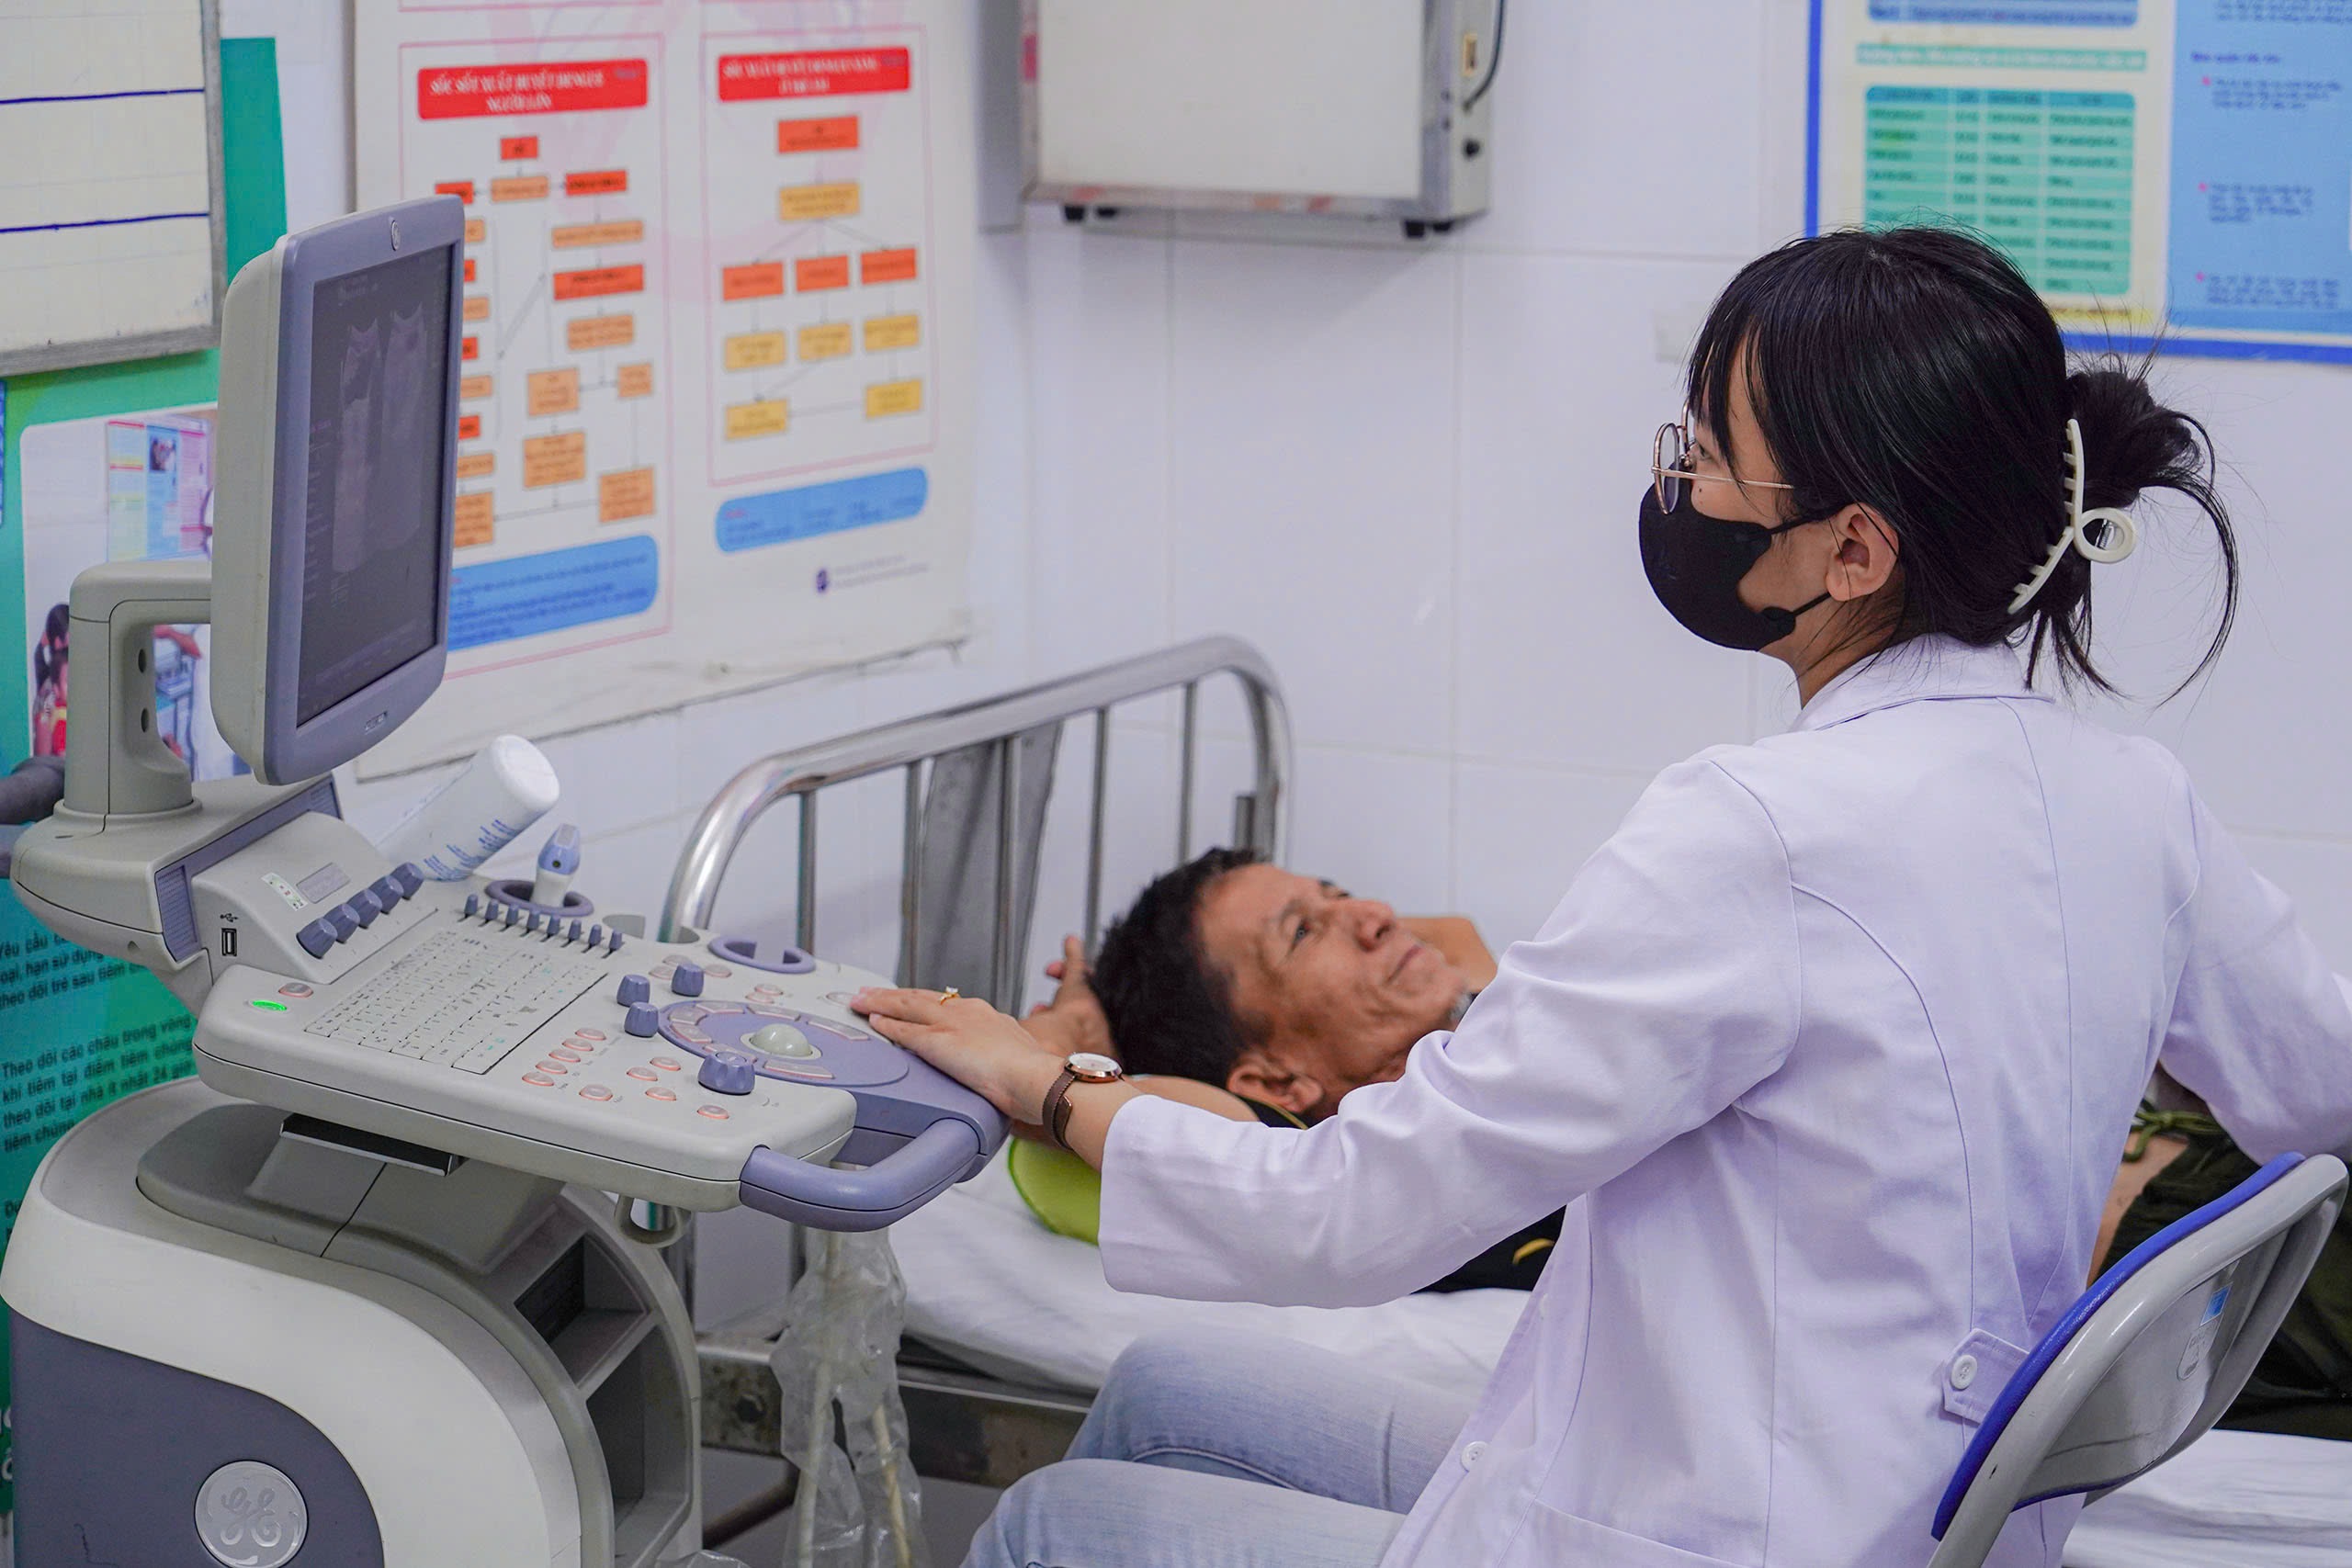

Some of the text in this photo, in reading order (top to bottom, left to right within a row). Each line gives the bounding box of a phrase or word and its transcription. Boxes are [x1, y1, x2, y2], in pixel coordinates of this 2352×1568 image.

[73, 971, 95, 989] sau
[2, 1059, 33, 1078] Theo
[38, 1050, 57, 1070] dõi
[122, 1023, 157, 1045] trong
[2, 1085, 22, 1104] khi
[28, 1077, 56, 1097] tiêm
[61, 1069, 77, 1089] tại
[120, 1050, 149, 1070] tiêm
[3, 1109, 31, 1129] theo
[35, 1100, 56, 1118] dõi
[60, 1093, 76, 1111] tại
[4, 1134, 32, 1153] tiêm
